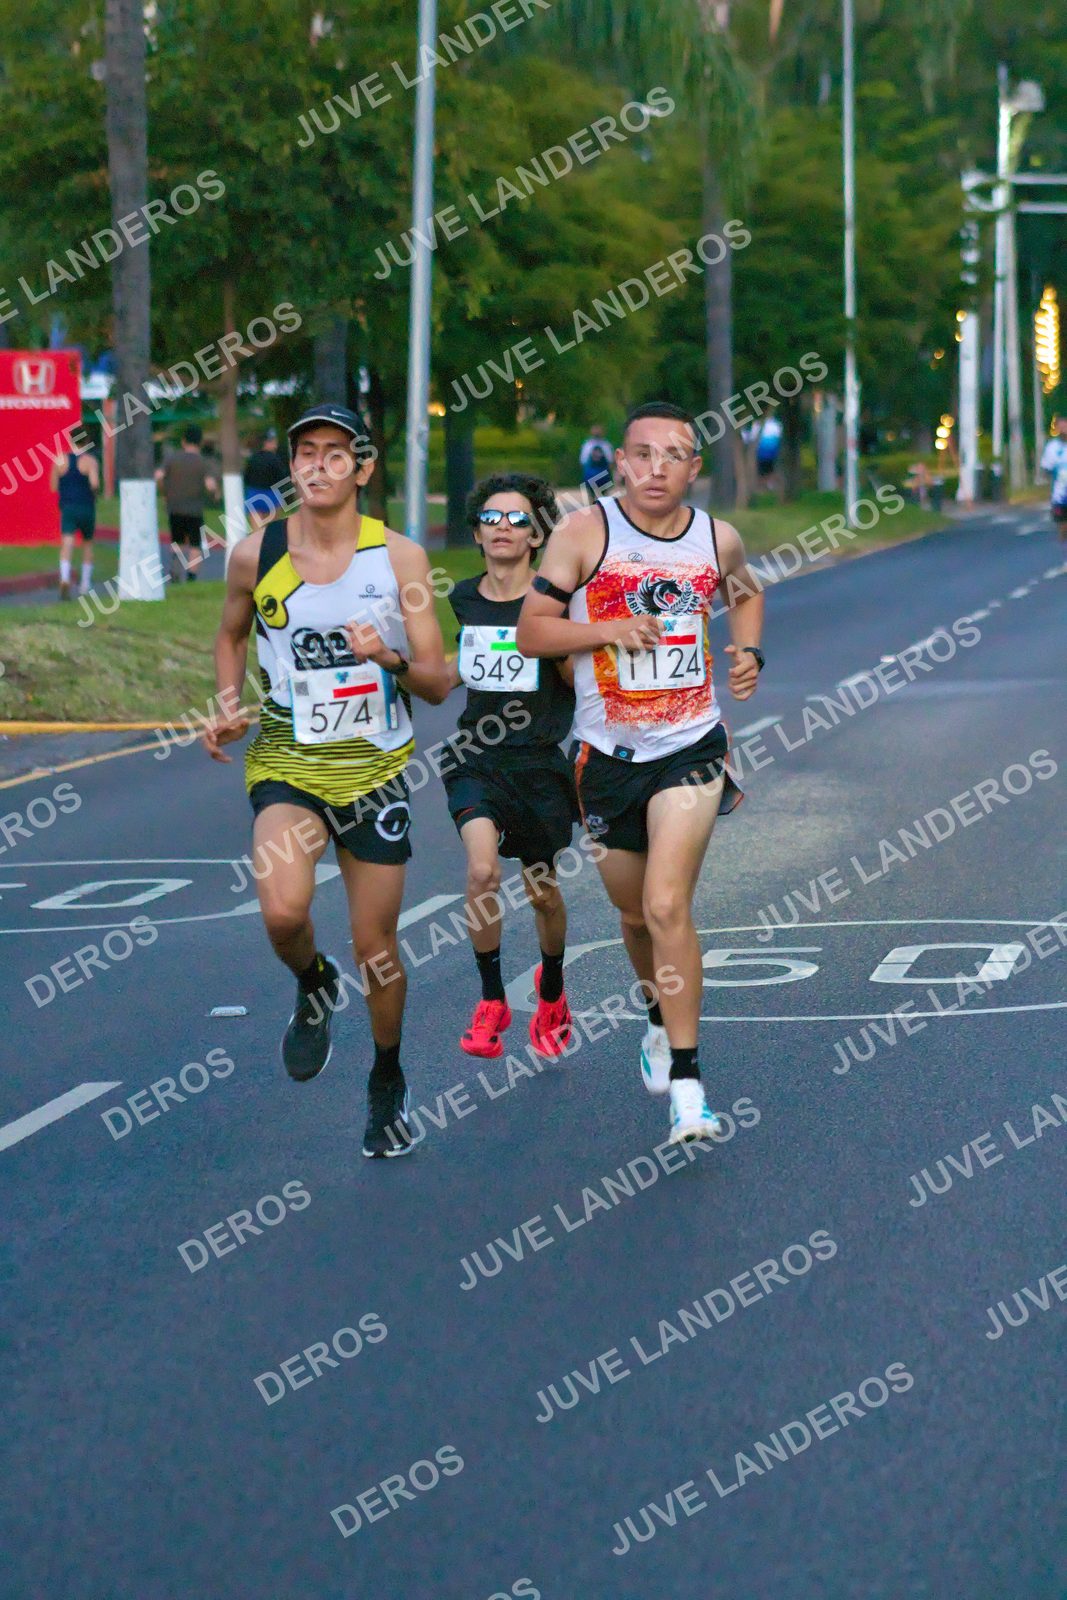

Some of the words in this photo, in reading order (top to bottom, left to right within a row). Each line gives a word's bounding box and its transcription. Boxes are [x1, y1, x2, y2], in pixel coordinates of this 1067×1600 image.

[471, 654, 524, 682] 549
[627, 646, 701, 680] 1124
[310, 697, 373, 733] 574
